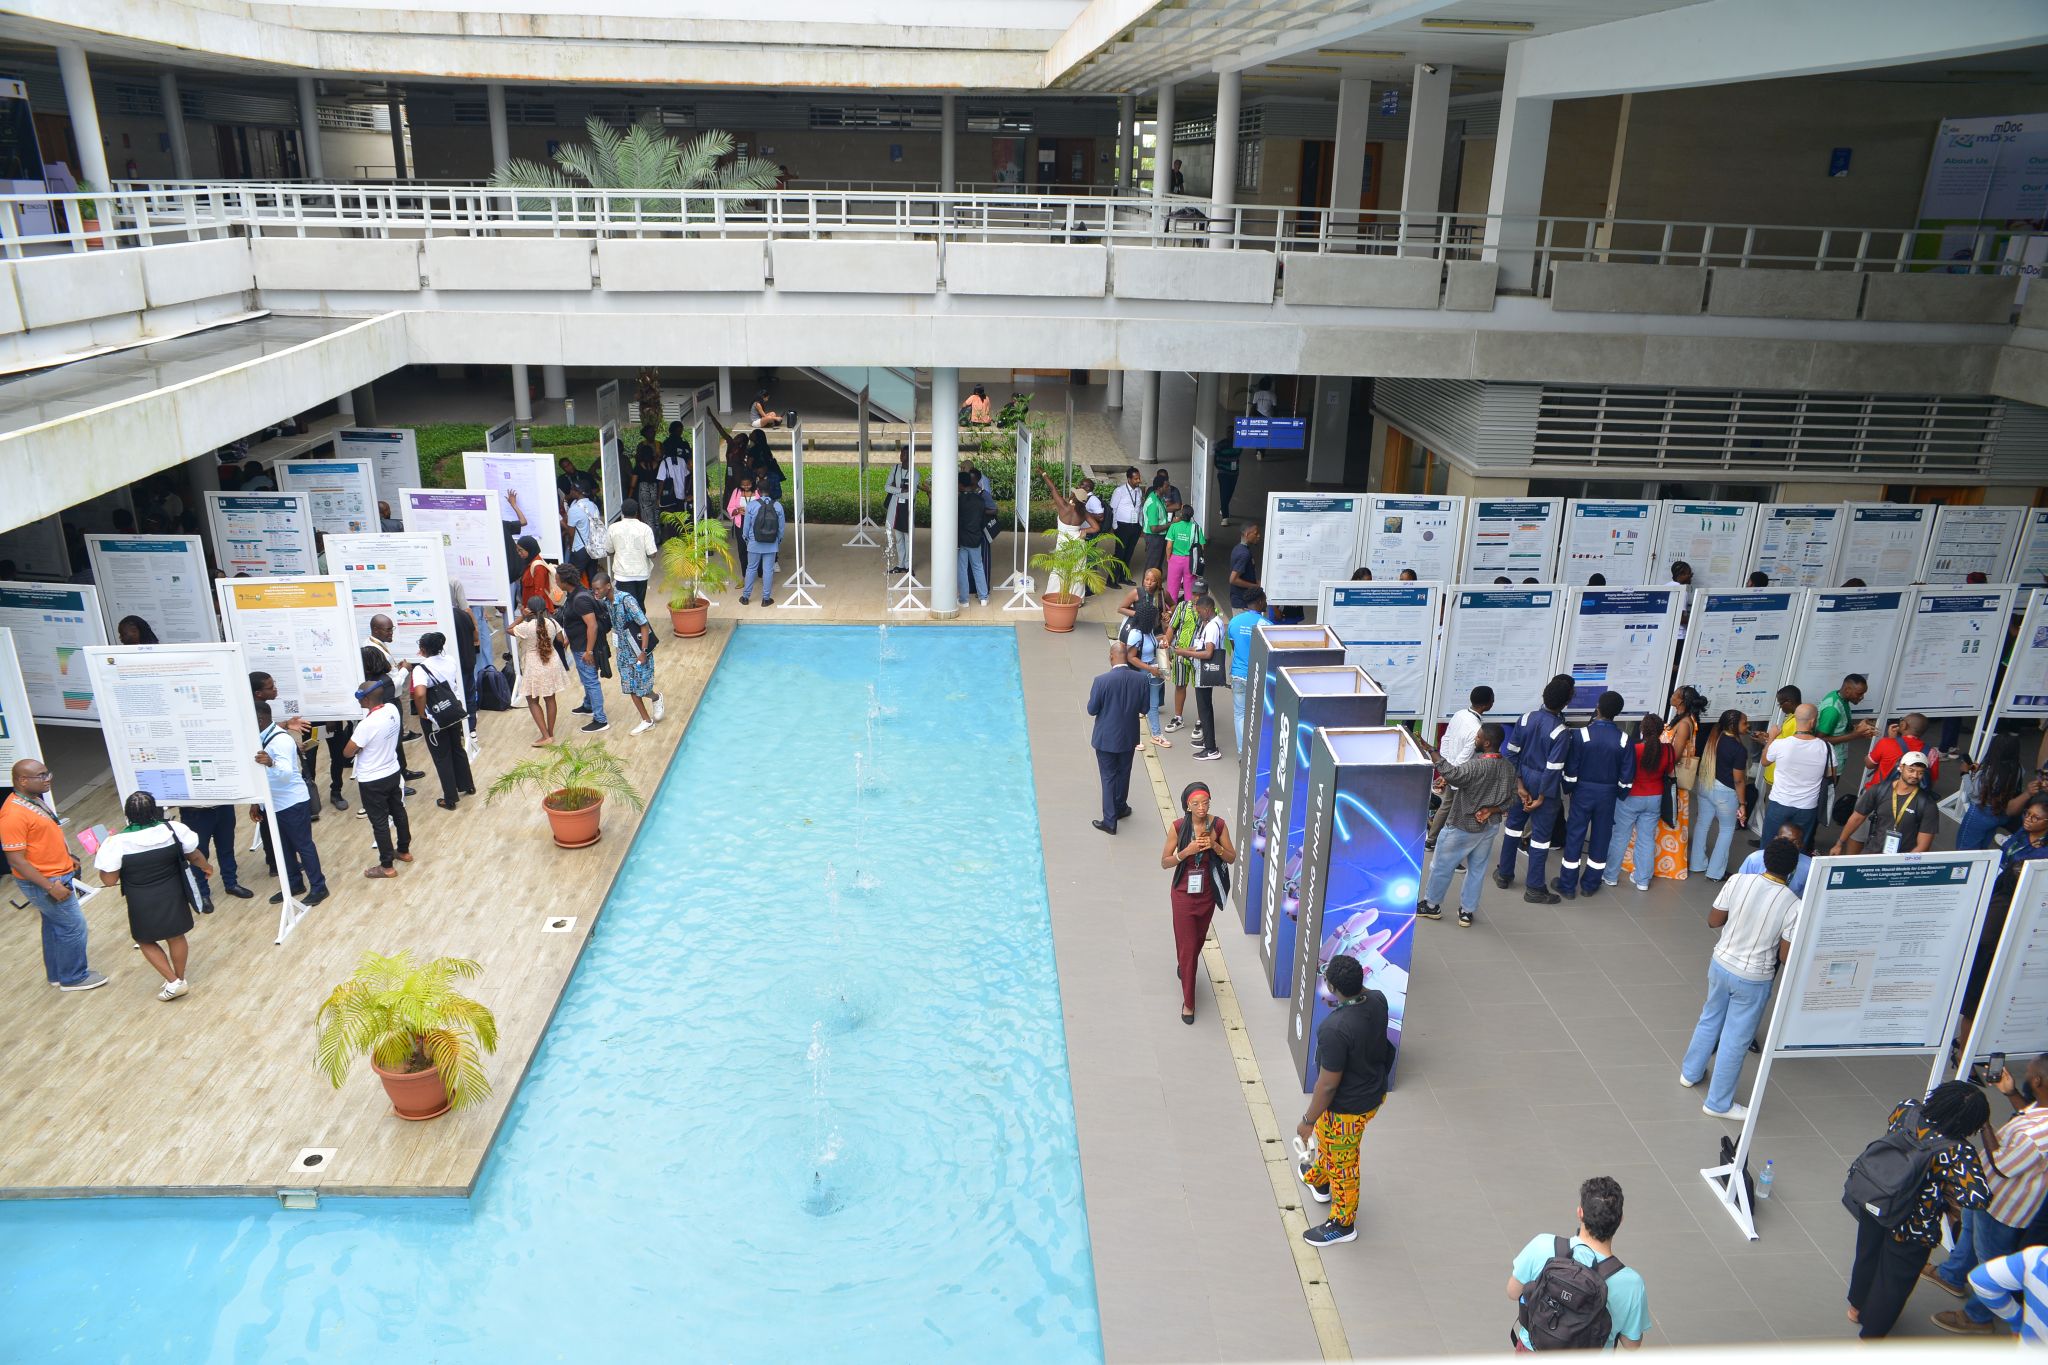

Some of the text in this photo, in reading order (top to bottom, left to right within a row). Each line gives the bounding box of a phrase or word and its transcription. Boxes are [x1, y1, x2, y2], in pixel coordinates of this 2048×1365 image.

[1944, 157, 1989, 165] About Us
[1993, 121, 2023, 133] mDoc
[1244, 745, 1252, 798] Shared
[1248, 661, 1260, 742] Knowledge
[1264, 712, 1290, 959] NIGERIA 2026
[1300, 782, 1325, 1012] DEEP LEARNING INDABA
